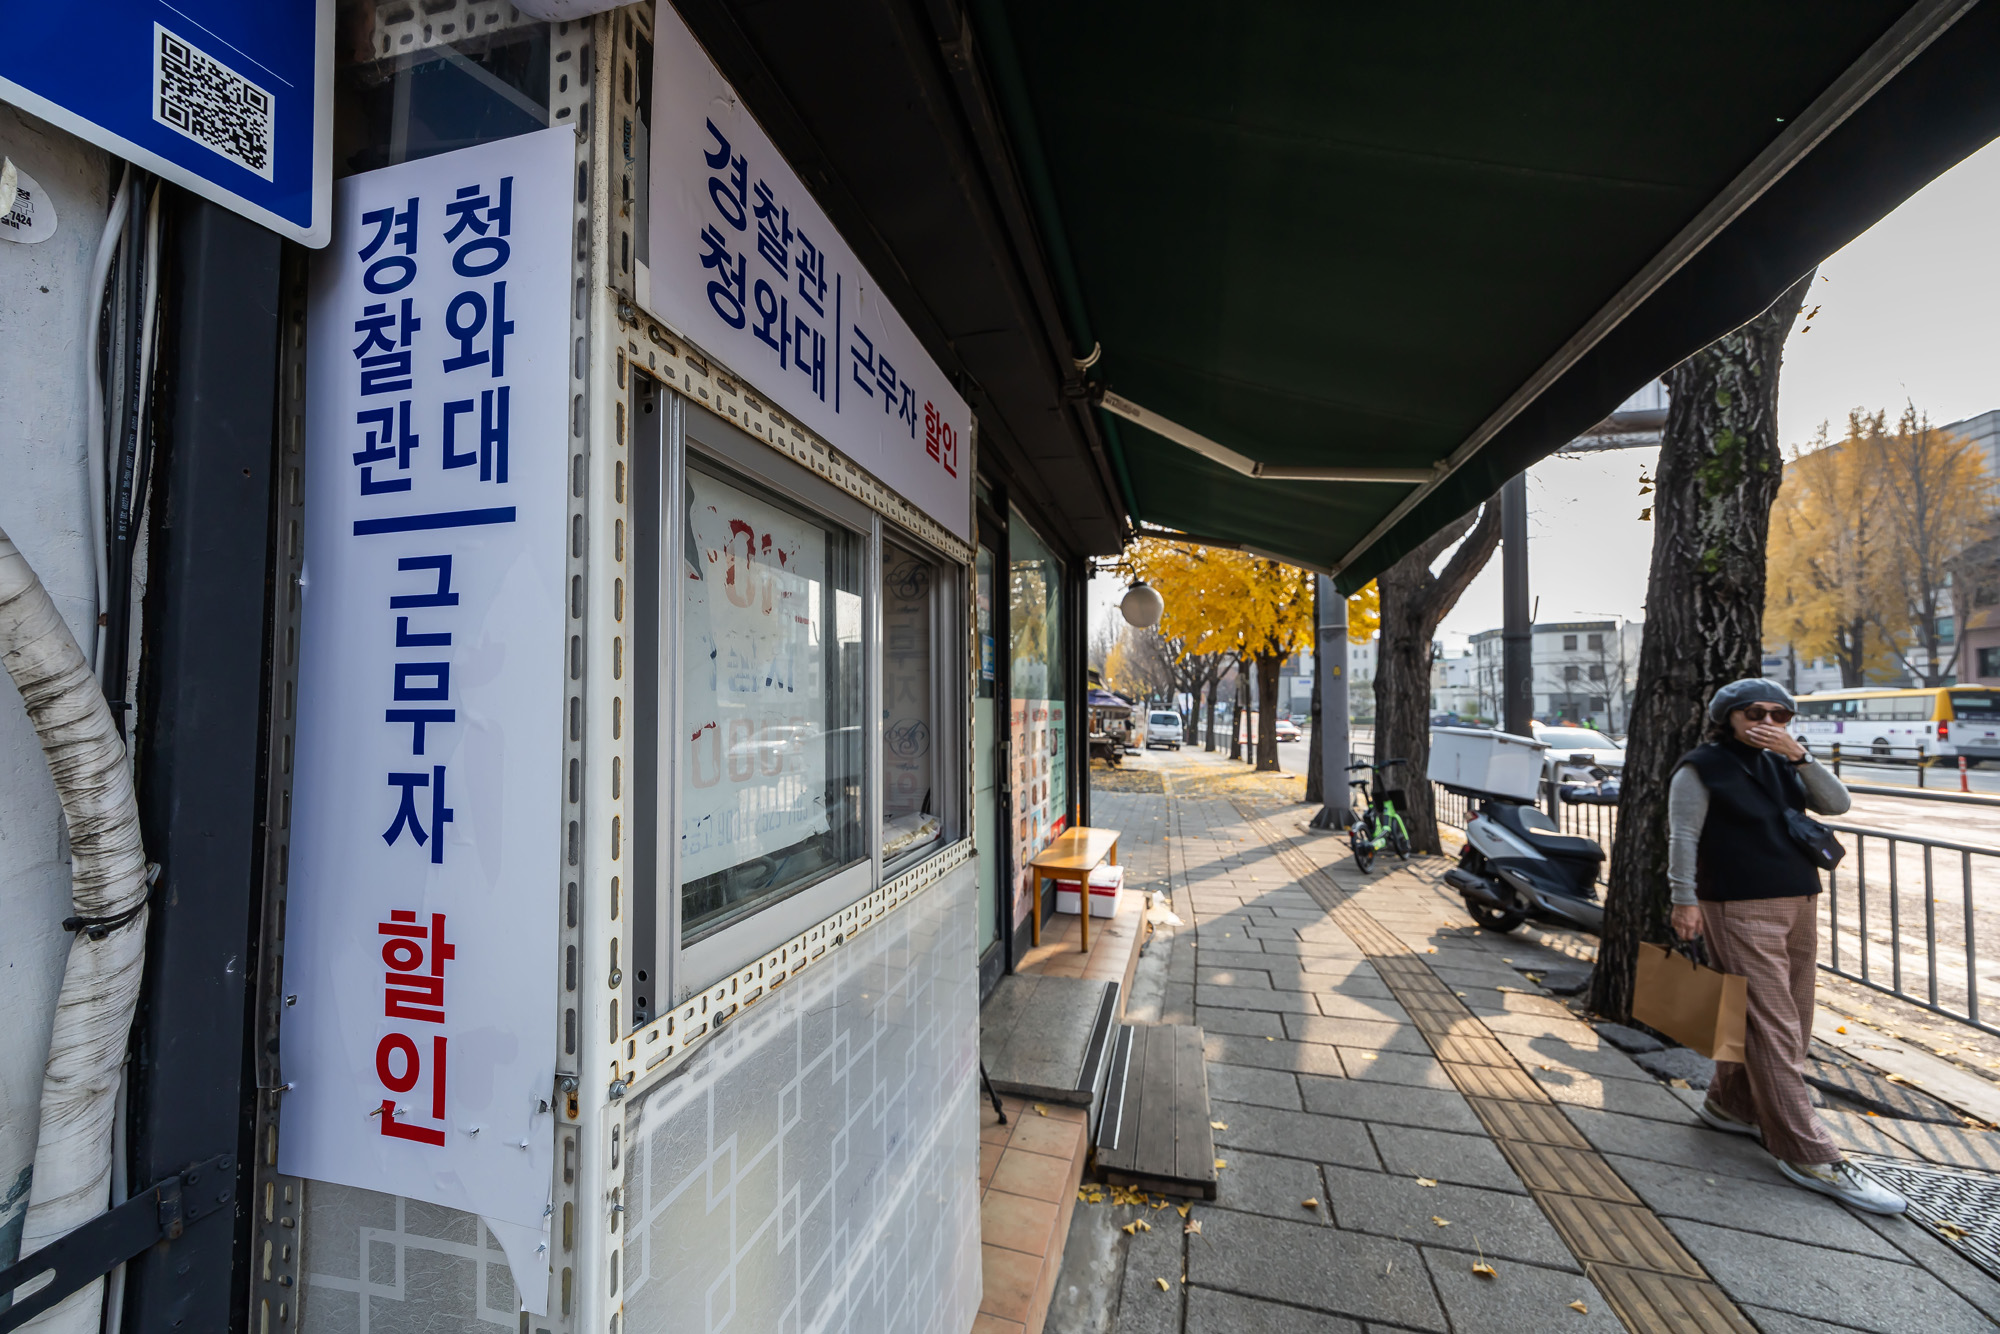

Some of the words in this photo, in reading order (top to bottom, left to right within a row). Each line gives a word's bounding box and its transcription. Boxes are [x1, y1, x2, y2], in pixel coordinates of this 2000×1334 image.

[443, 176, 515, 484] 청와대
[699, 222, 827, 403] 청와대
[703, 116, 828, 319] 경찰관
[353, 197, 422, 497] 경찰관
[850, 324, 917, 439] 근무자
[924, 400, 958, 480] 할인
[382, 555, 460, 865] 근무자
[377, 909, 455, 1147] 할인
